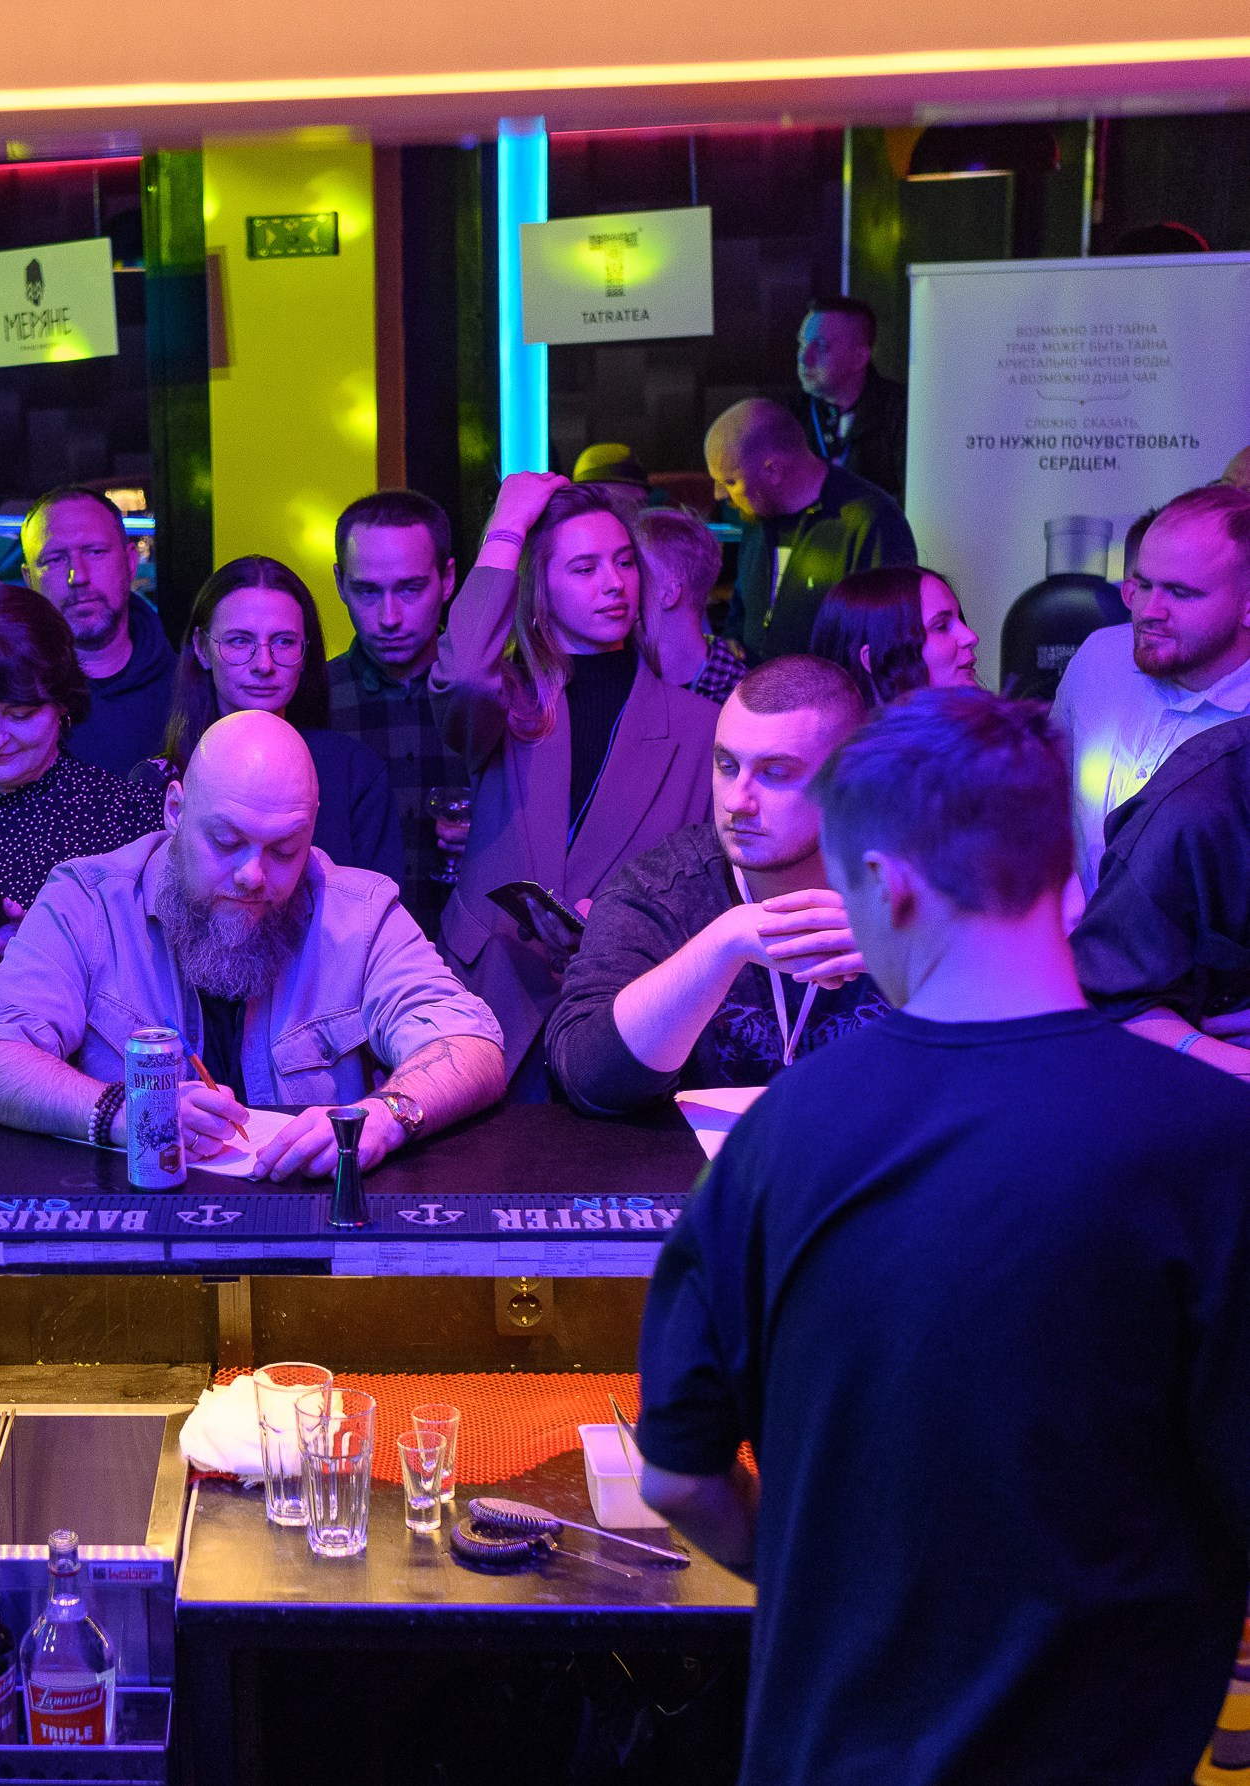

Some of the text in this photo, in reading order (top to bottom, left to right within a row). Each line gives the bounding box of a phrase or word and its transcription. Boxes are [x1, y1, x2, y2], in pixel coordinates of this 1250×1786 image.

[582, 309, 650, 324] TATRATEA
[1090, 324, 1114, 336] ЭТО
[1117, 322, 1158, 334] ТАЙНА
[1042, 341, 1085, 352] МОЖЕТ
[1089, 341, 1124, 352] БЫТЬ
[1128, 338, 1168, 350] ТАЙНА
[1081, 355, 1130, 368] ЧИСТОЙ
[1020, 372, 1090, 384] ВОЗМОЖНО
[1093, 371, 1130, 386] ДУША
[1024, 417, 1077, 430] СЛОЖНО
[966, 434, 1200, 450] ЭТО НУЖНО ПОЧУВСТВОВАТЬ
[133, 1072, 177, 1090] BARRIST
[573, 1197, 655, 1211] GIN
[491, 1208, 683, 1232] RRISTER
[40, 1722, 93, 1741] TRIPLE
